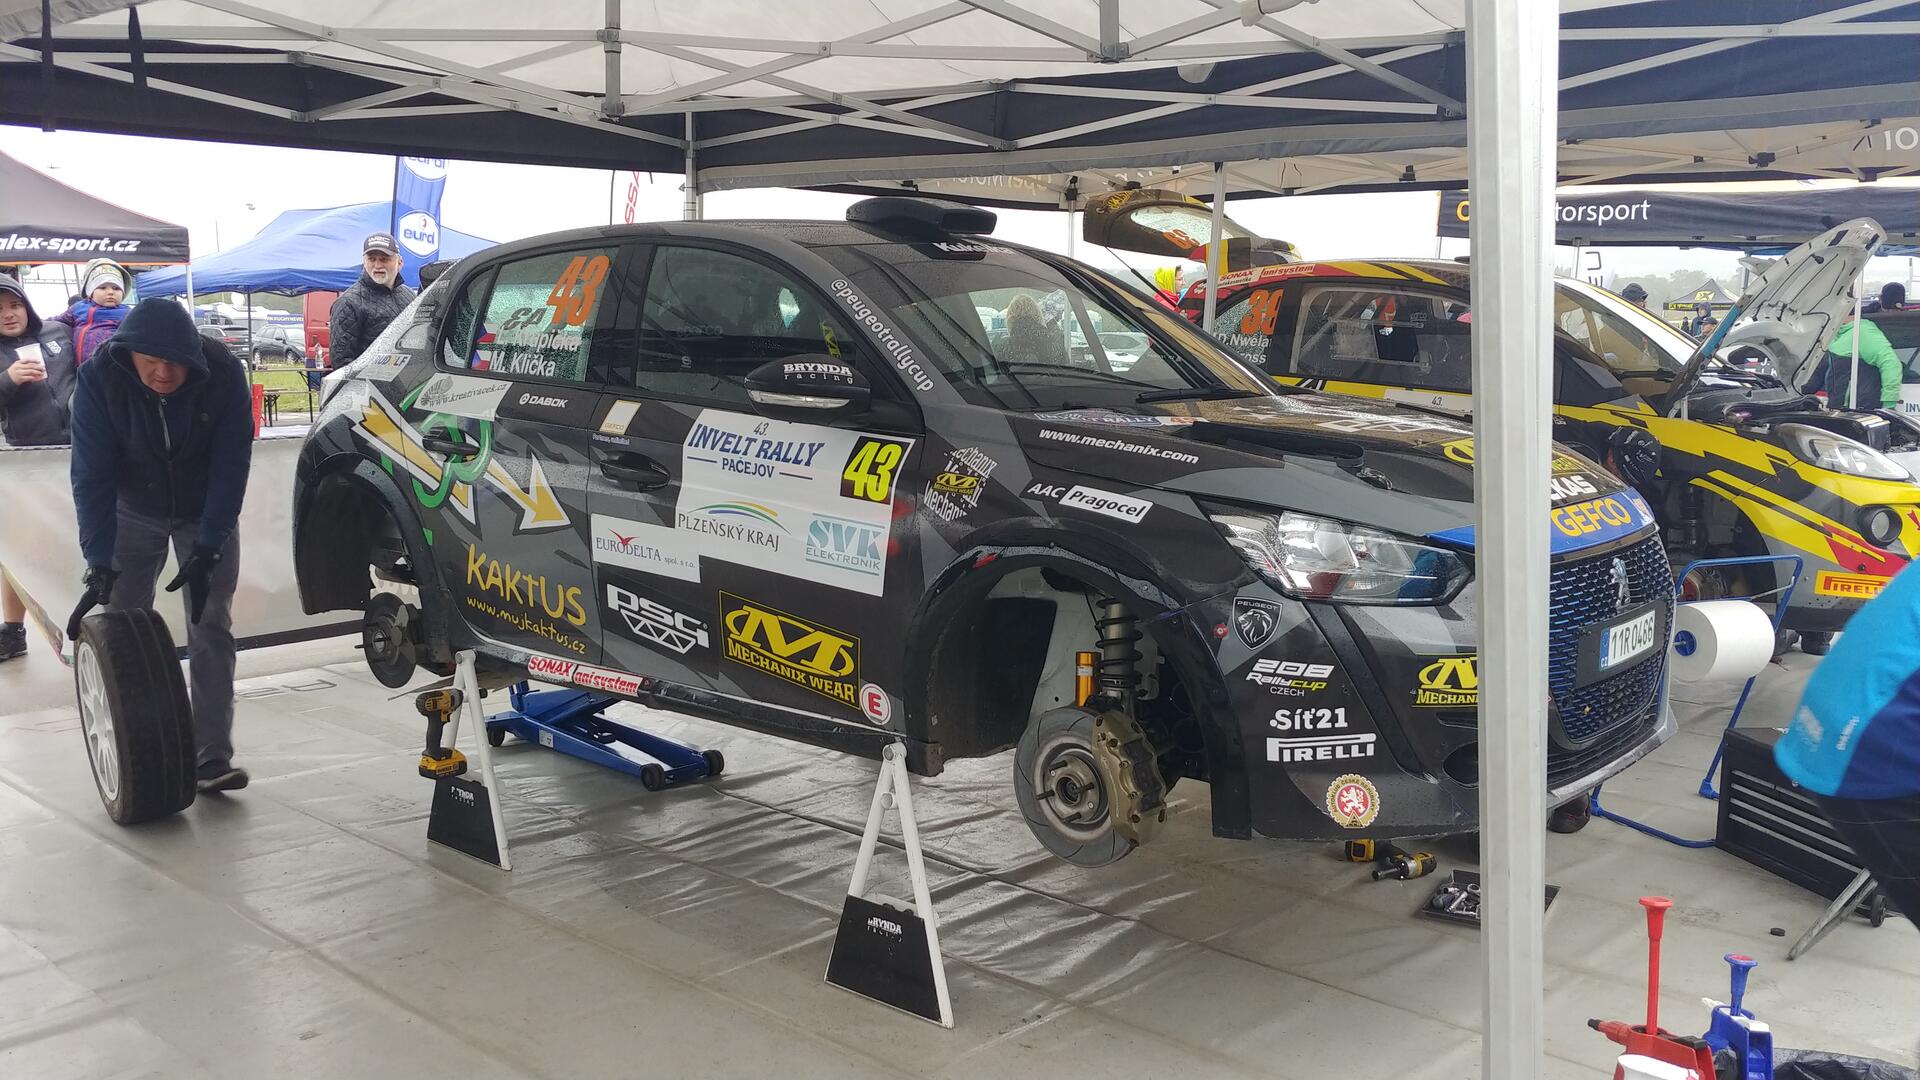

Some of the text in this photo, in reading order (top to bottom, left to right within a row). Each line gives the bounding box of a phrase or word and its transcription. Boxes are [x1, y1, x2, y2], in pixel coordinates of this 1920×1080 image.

[1555, 200, 1651, 226] torsport
[1220, 270, 1253, 282] SONAX
[546, 255, 610, 327] 43
[830, 278, 935, 393] @peugeotrallycup
[510, 352, 557, 377] Klička
[783, 362, 853, 378] BRYNDA
[529, 394, 569, 408] DABOK
[688, 423, 825, 468] INVELT RALLY
[1038, 428, 1200, 465] www.mechanix.com
[721, 457, 775, 479] PAČEJOV
[843, 440, 903, 503] 43
[1027, 482, 1147, 518] AAC Pragocel
[1550, 497, 1632, 537] GEFCO
[678, 513, 780, 553] PLZEŇSKÝ KRAJ
[806, 519, 882, 560] SVK
[595, 537, 662, 562] EURODELTA
[805, 546, 881, 570] ELEKTRONIK
[467, 543, 587, 626] KAKTUS
[1237, 600, 1279, 610] PEUGEOT
[466, 596, 587, 655] www.mujkaktus.cz
[528, 655, 574, 677] SONAX
[727, 637, 856, 703] MECHANIX WEAR
[1251, 658, 1335, 679] 208
[867, 691, 883, 716] E
[1269, 685, 1305, 697] CZECH
[1416, 688, 1478, 704] MECHANI
[1266, 733, 1377, 762] PIRELLI
